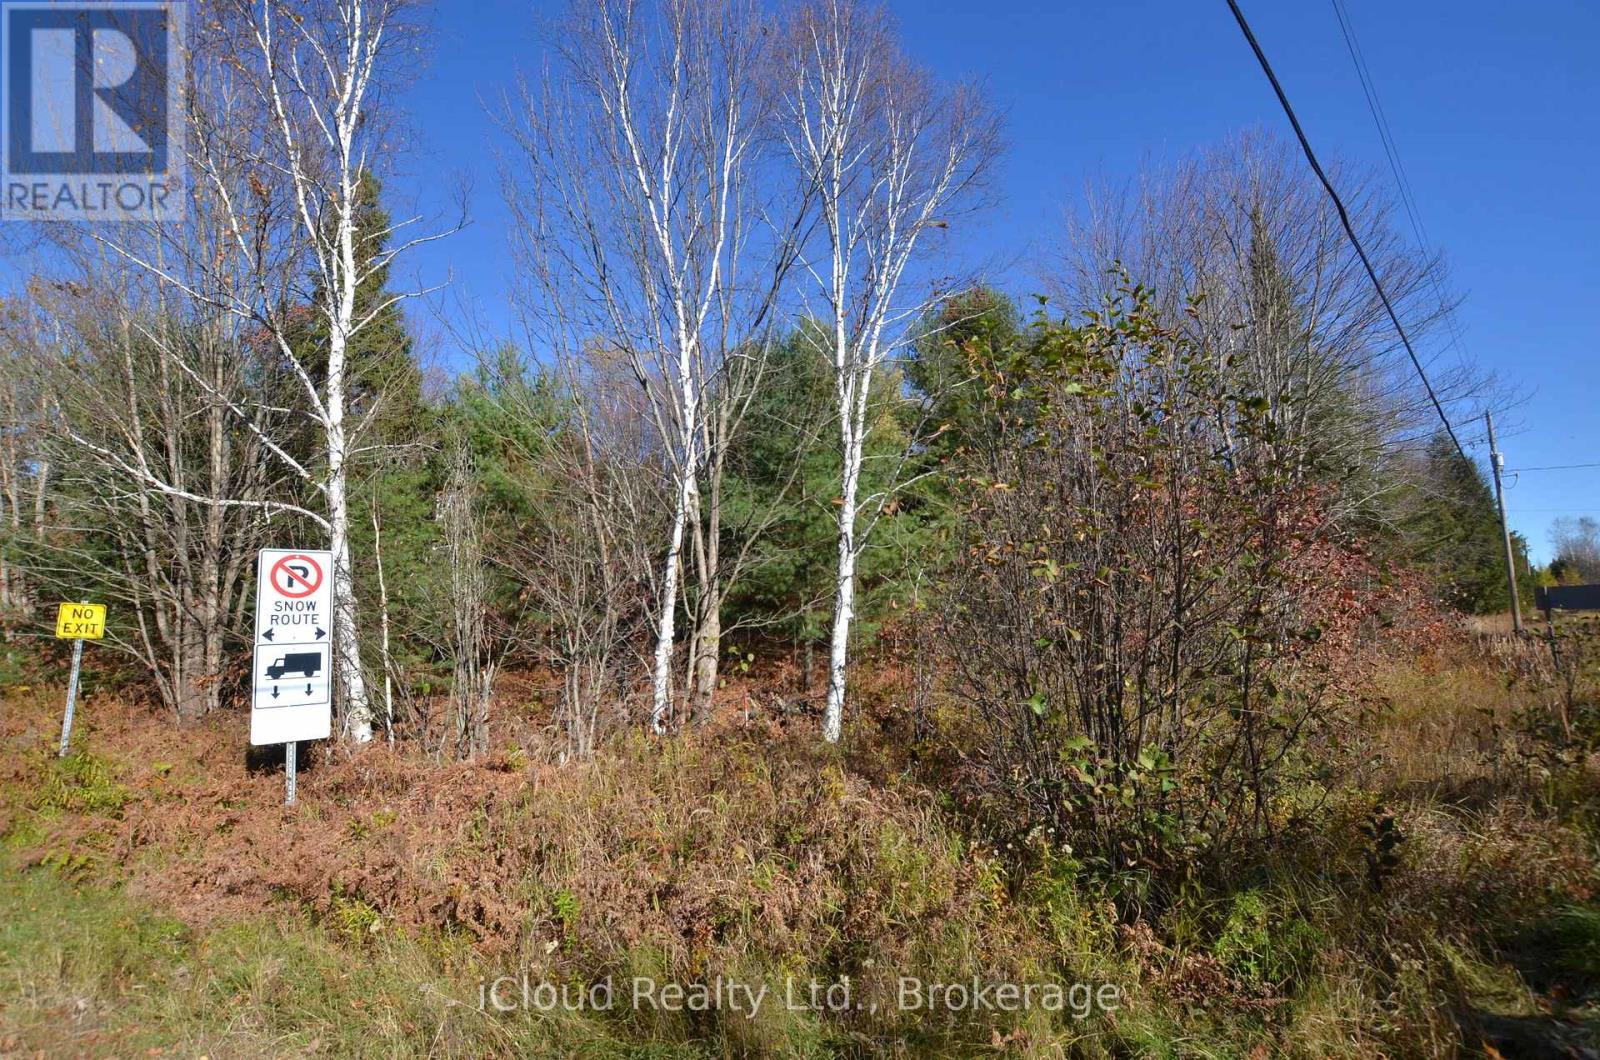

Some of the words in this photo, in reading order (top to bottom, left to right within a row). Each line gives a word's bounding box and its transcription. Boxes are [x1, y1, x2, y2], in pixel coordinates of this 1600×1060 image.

[287, 565, 309, 588] P
[274, 601, 317, 612] SNOW
[72, 608, 94, 619] NO
[270, 614, 320, 625] ROUTE
[63, 623, 99, 634] EXIT
